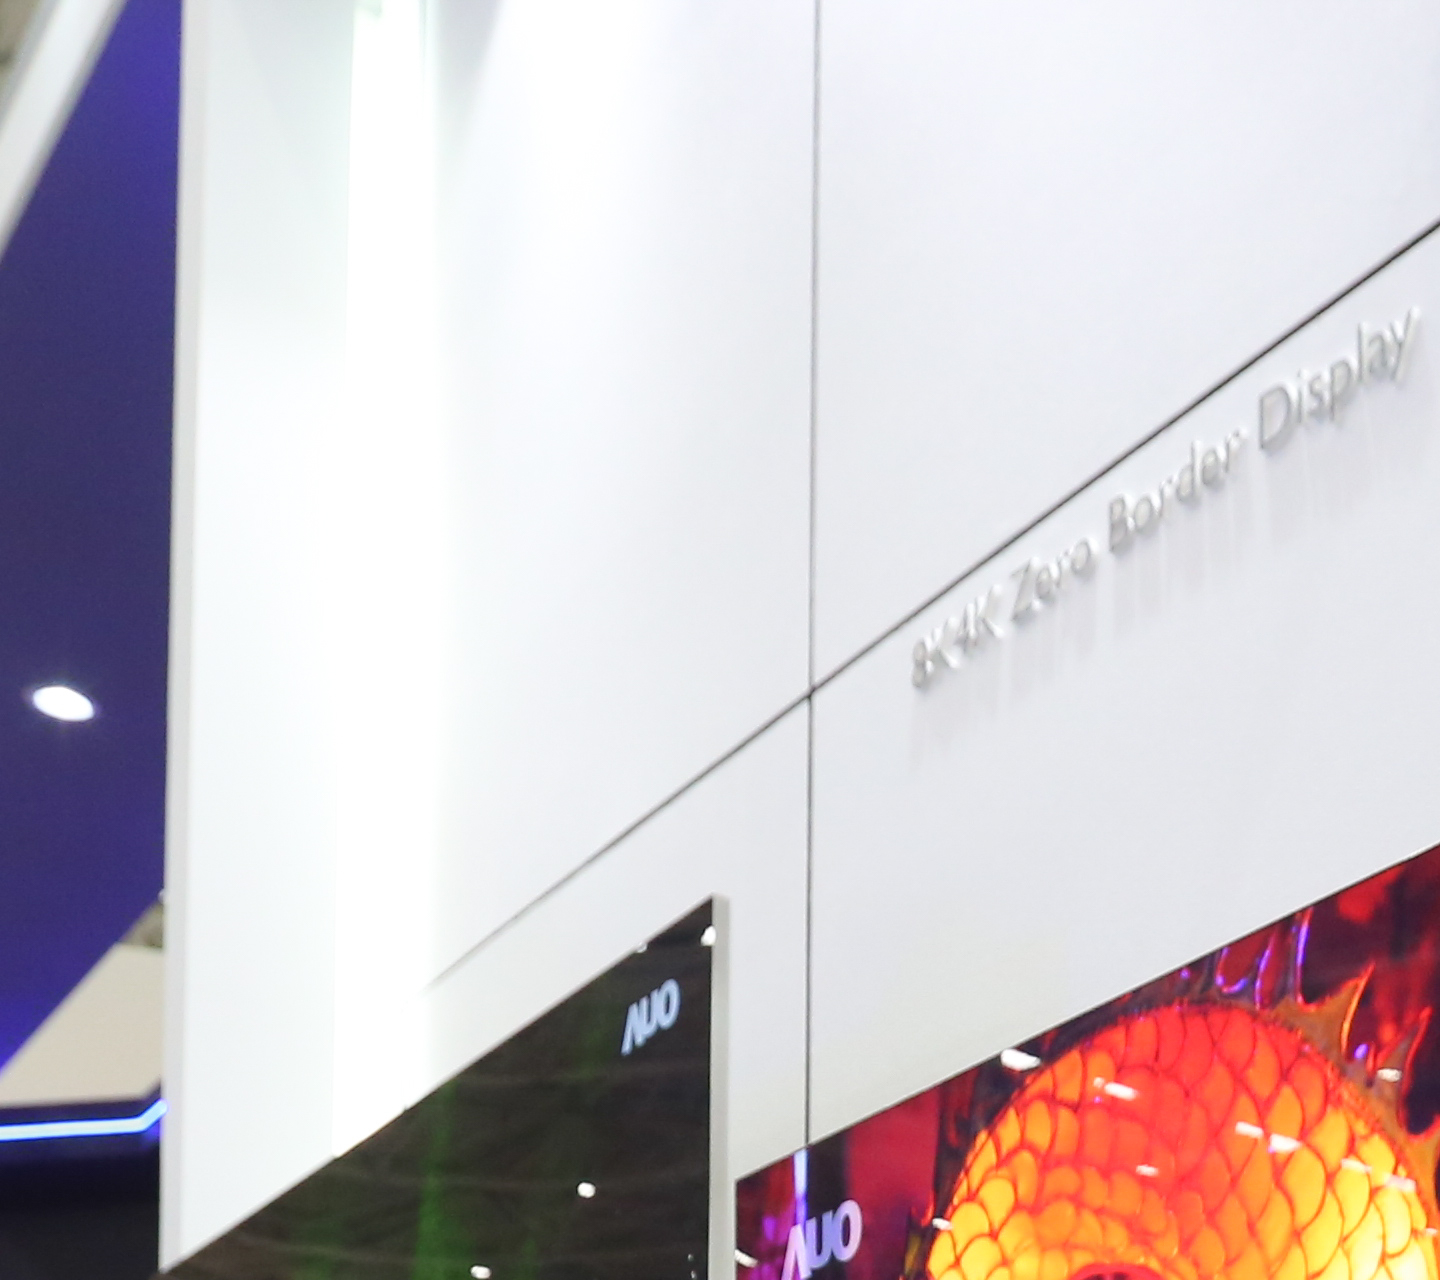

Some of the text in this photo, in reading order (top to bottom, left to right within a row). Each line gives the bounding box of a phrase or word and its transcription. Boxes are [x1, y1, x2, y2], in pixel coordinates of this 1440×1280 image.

[909, 306, 1420, 688] 8K4K Zero Border Display
[621, 978, 681, 1056] AUO
